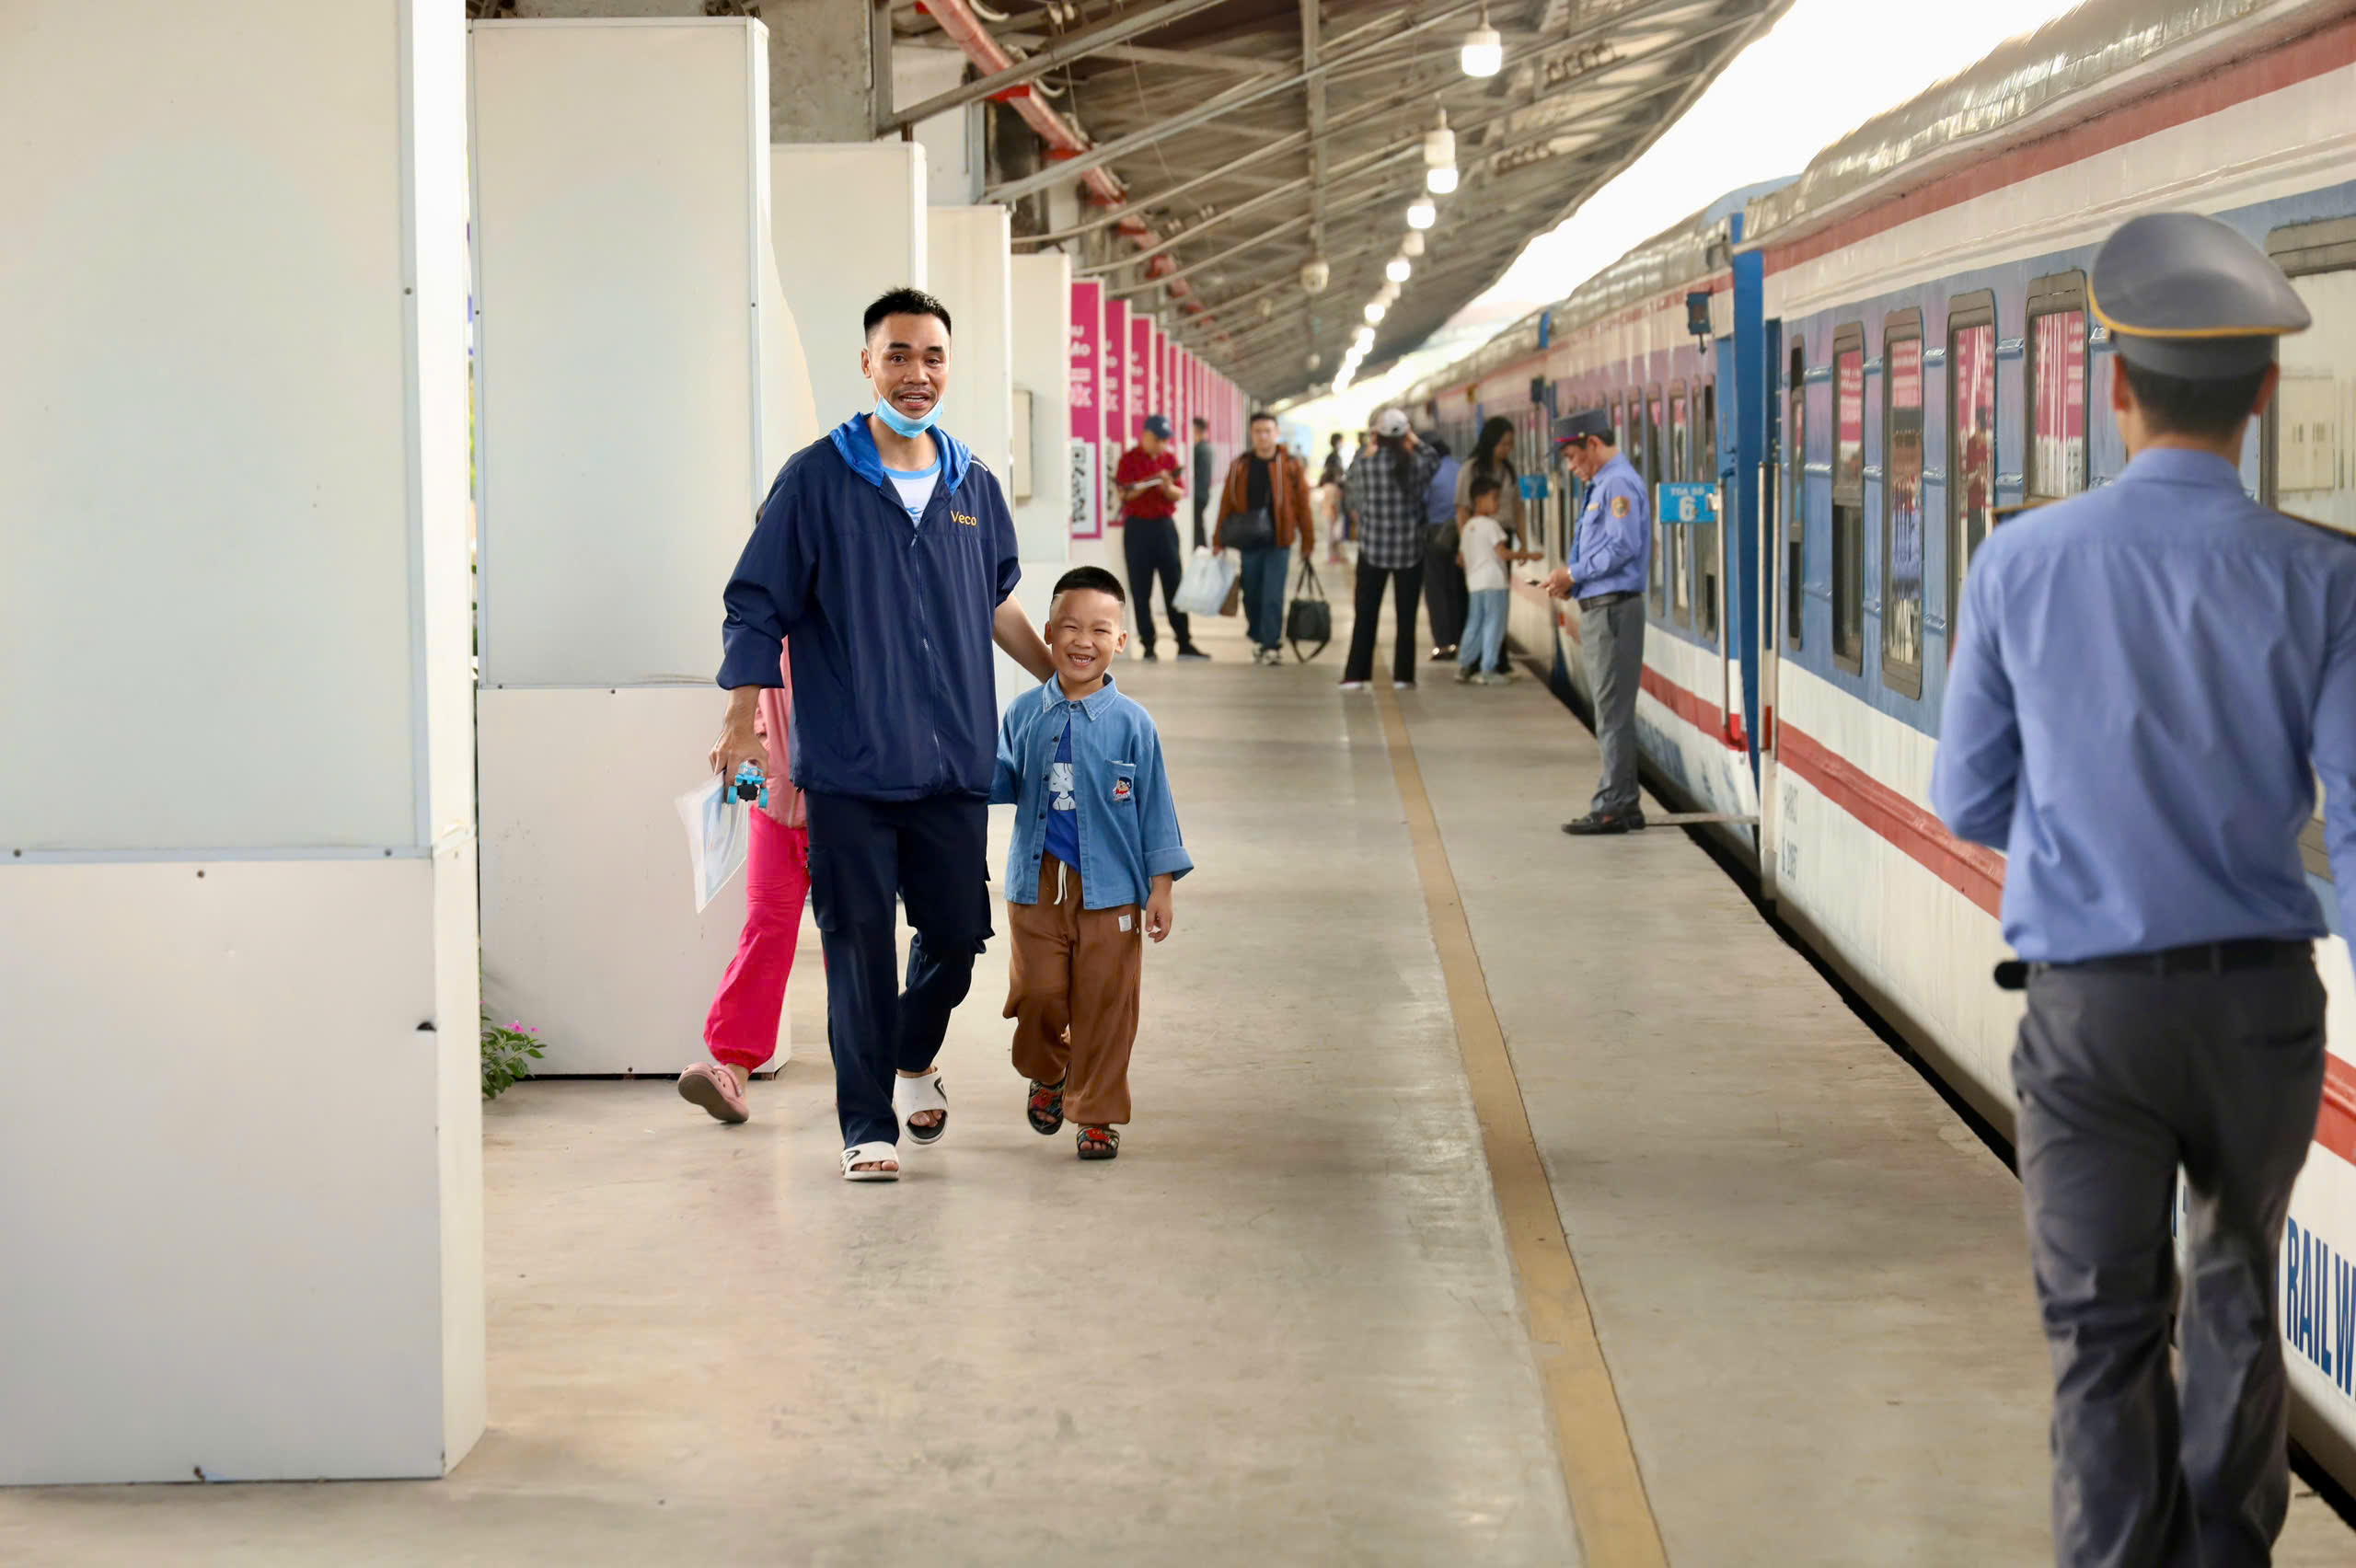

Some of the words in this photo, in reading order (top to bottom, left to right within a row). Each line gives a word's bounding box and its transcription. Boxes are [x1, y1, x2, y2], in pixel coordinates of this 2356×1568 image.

[950, 510, 977, 526] Veco
[1680, 496, 1696, 522] 6
[2287, 1215, 2356, 1399] RAILW
